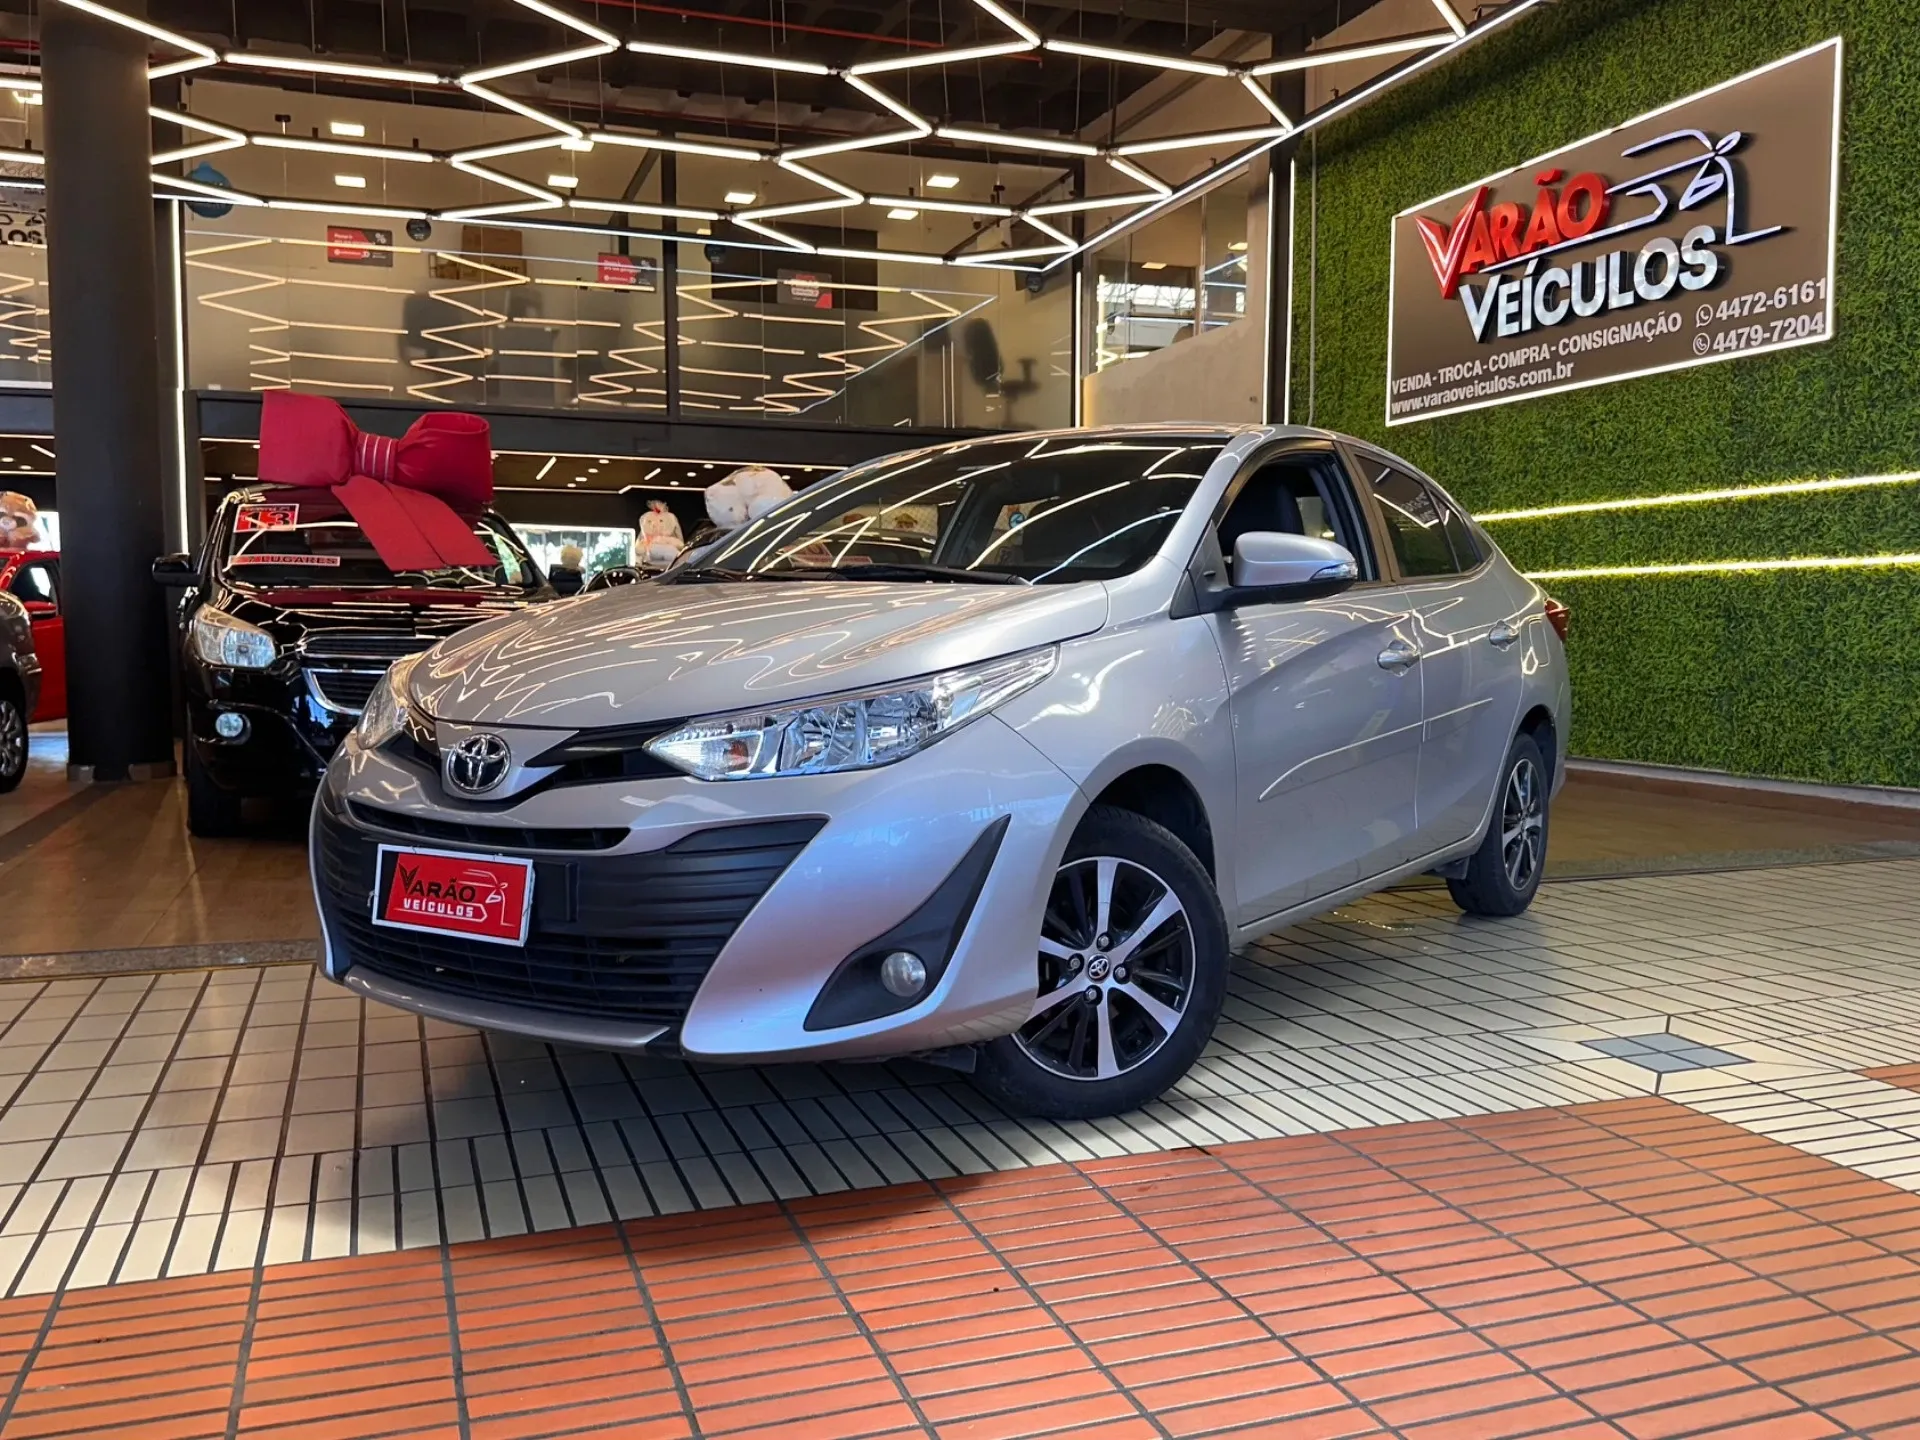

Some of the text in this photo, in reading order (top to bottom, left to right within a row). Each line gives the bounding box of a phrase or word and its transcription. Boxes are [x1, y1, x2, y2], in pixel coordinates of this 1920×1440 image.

[1415, 168, 1612, 299] VARÃO
[1458, 225, 1718, 343] VEÍCULOS
[1715, 277, 1826, 320] 4472-6161
[1712, 312, 1824, 353] 4479-7204
[1391, 362, 1574, 415] www.varaoveiculos.com.br
[261, 555, 338, 564] LUGARES
[398, 863, 475, 903] VARÃO
[403, 898, 474, 918] VEÍCULOS
